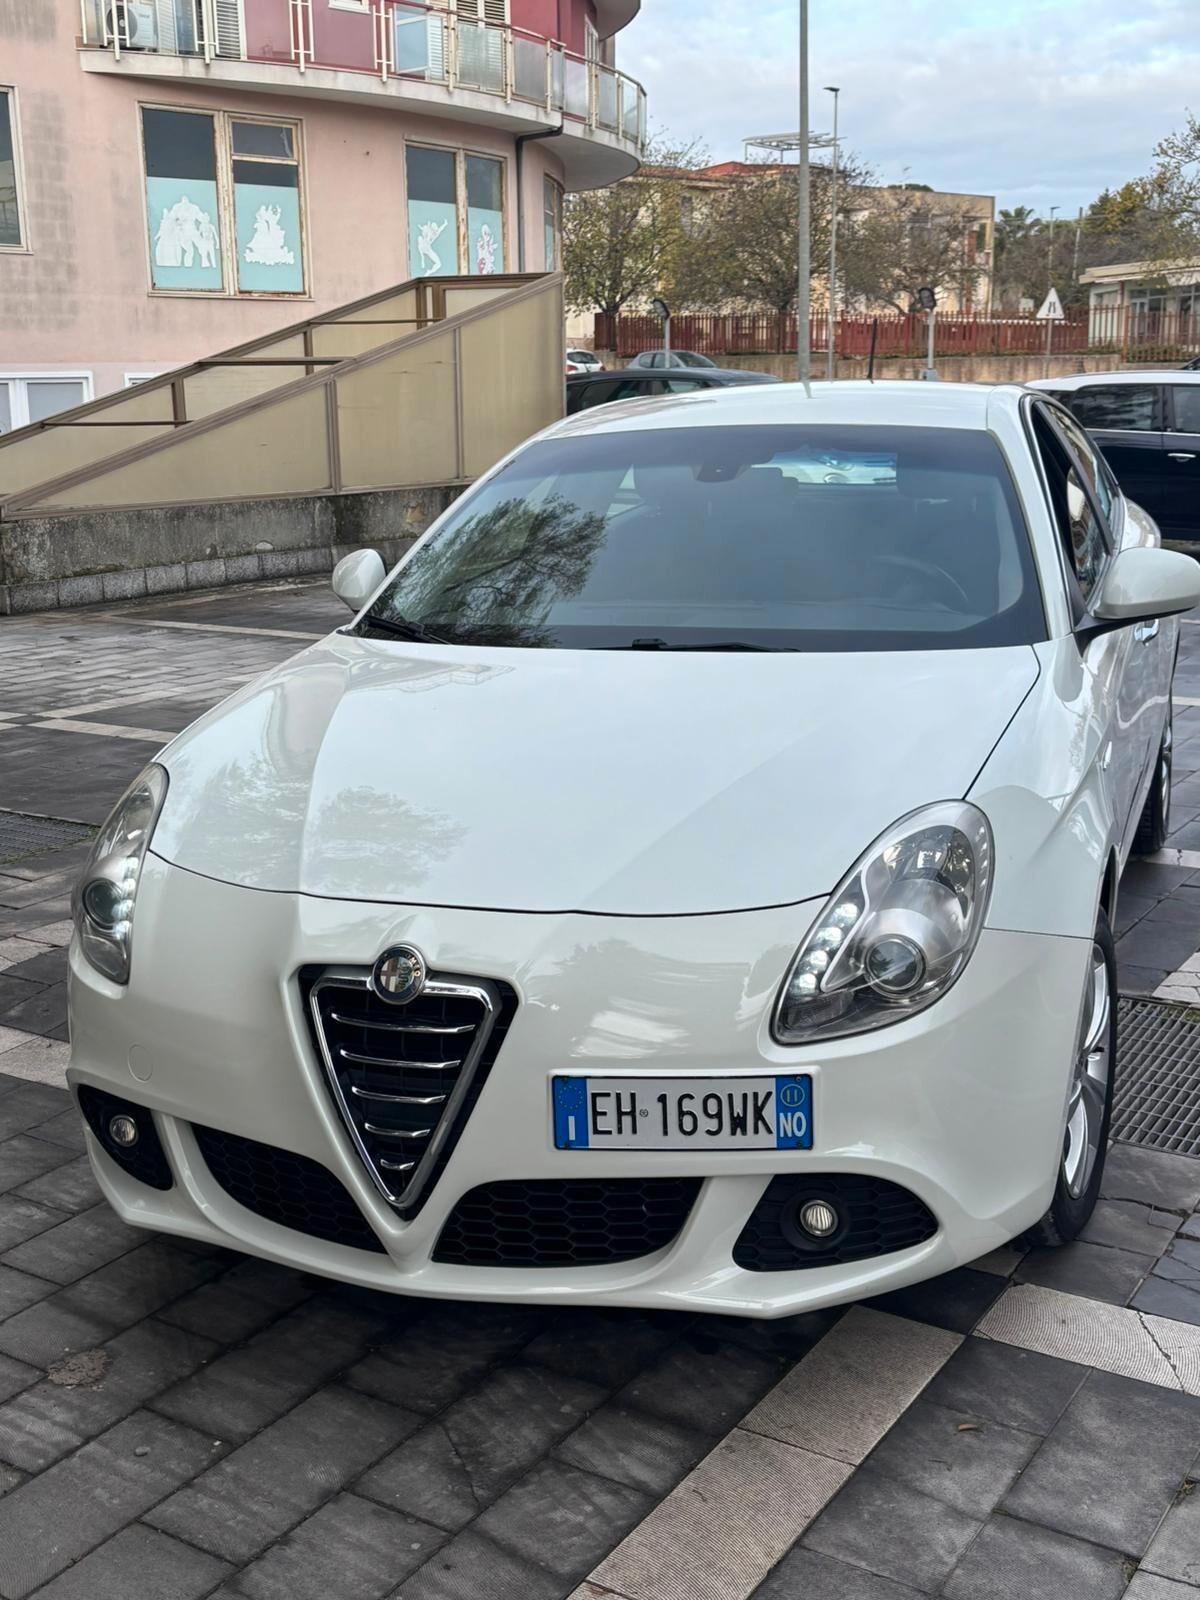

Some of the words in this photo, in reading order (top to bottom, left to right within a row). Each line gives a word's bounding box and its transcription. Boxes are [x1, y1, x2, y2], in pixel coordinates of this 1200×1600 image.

[590, 1091, 638, 1136] EH
[657, 1091, 774, 1137] 169WK
[779, 1111, 807, 1138] NO
[568, 1115, 576, 1141] I
